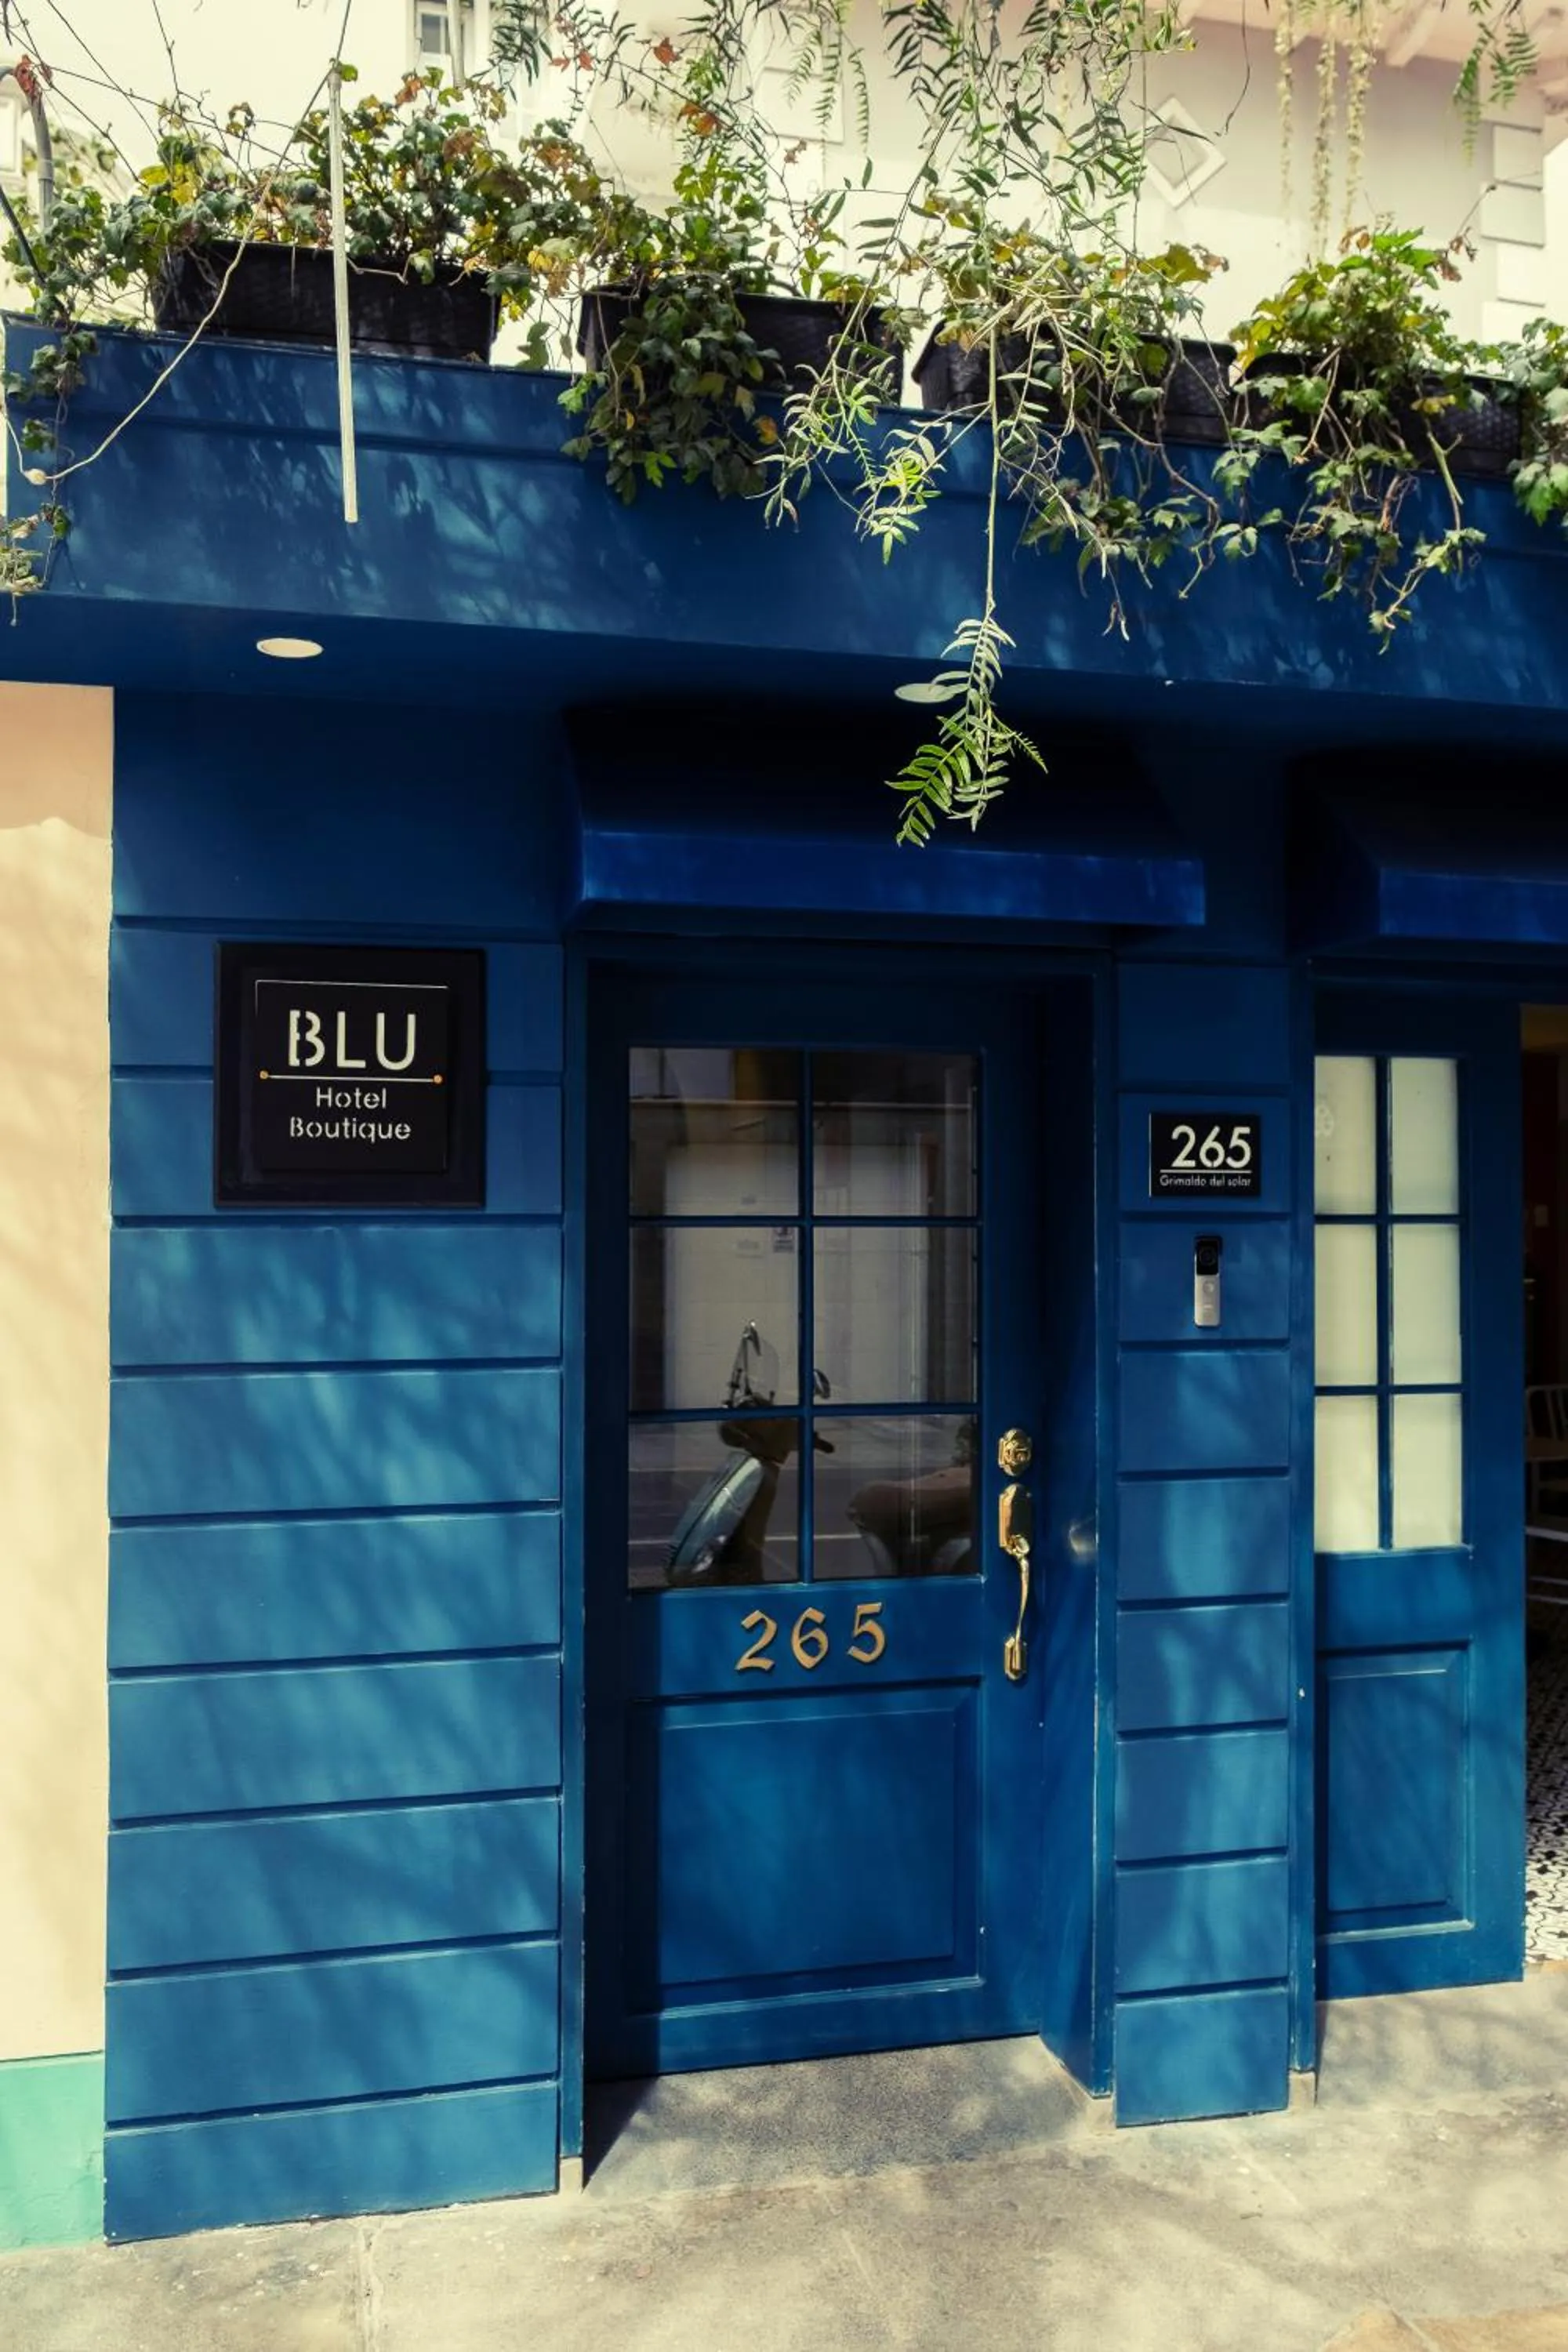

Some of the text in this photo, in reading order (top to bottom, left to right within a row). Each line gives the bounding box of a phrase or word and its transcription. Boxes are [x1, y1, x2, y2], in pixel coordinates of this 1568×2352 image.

[288, 1009, 416, 1070] BLU
[315, 1087, 387, 1109] Hotel
[289, 1116, 412, 1143] Boutique
[1171, 1124, 1251, 1168] 265
[1160, 1174, 1207, 1186] Grimaldo
[1210, 1174, 1225, 1186] del
[735, 1602, 885, 1671] 265
